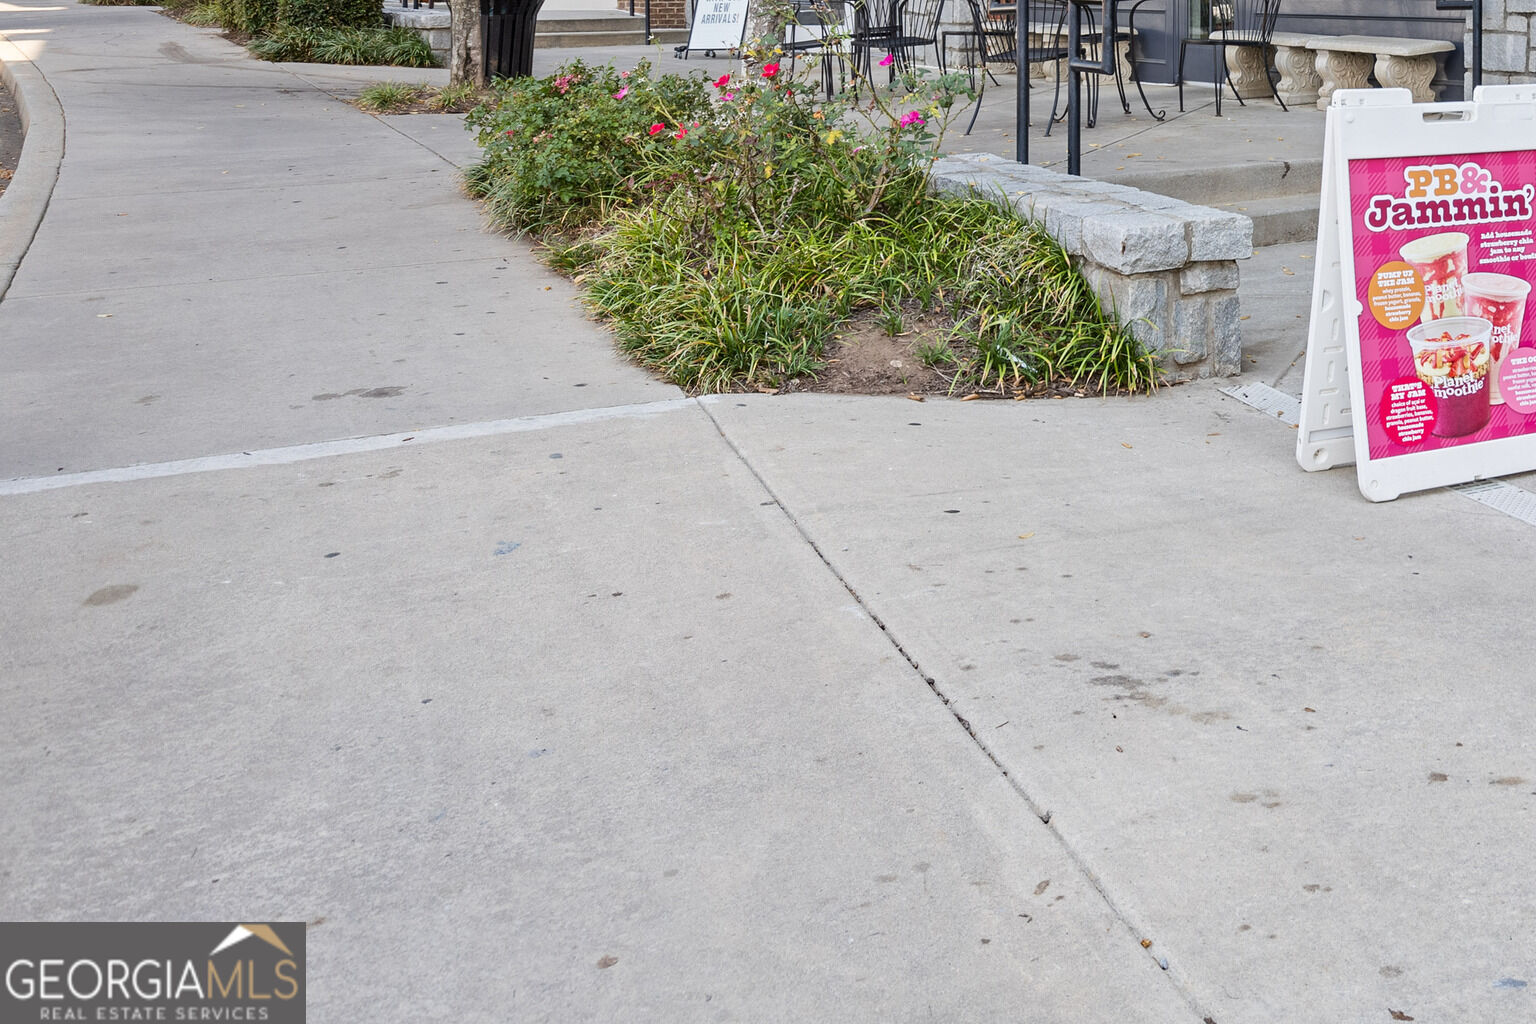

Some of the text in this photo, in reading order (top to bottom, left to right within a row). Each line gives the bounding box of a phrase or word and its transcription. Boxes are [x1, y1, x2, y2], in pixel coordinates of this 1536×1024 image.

[713, 3, 730, 12] NEW
[701, 13, 739, 24] ARRIVALS!
[1408, 166, 1489, 198] PB&
[1368, 186, 1532, 227] Jammin'
[1479, 255, 1510, 264] smoothie
[1431, 377, 1485, 399] moothie
[1433, 370, 1475, 388] Planet
